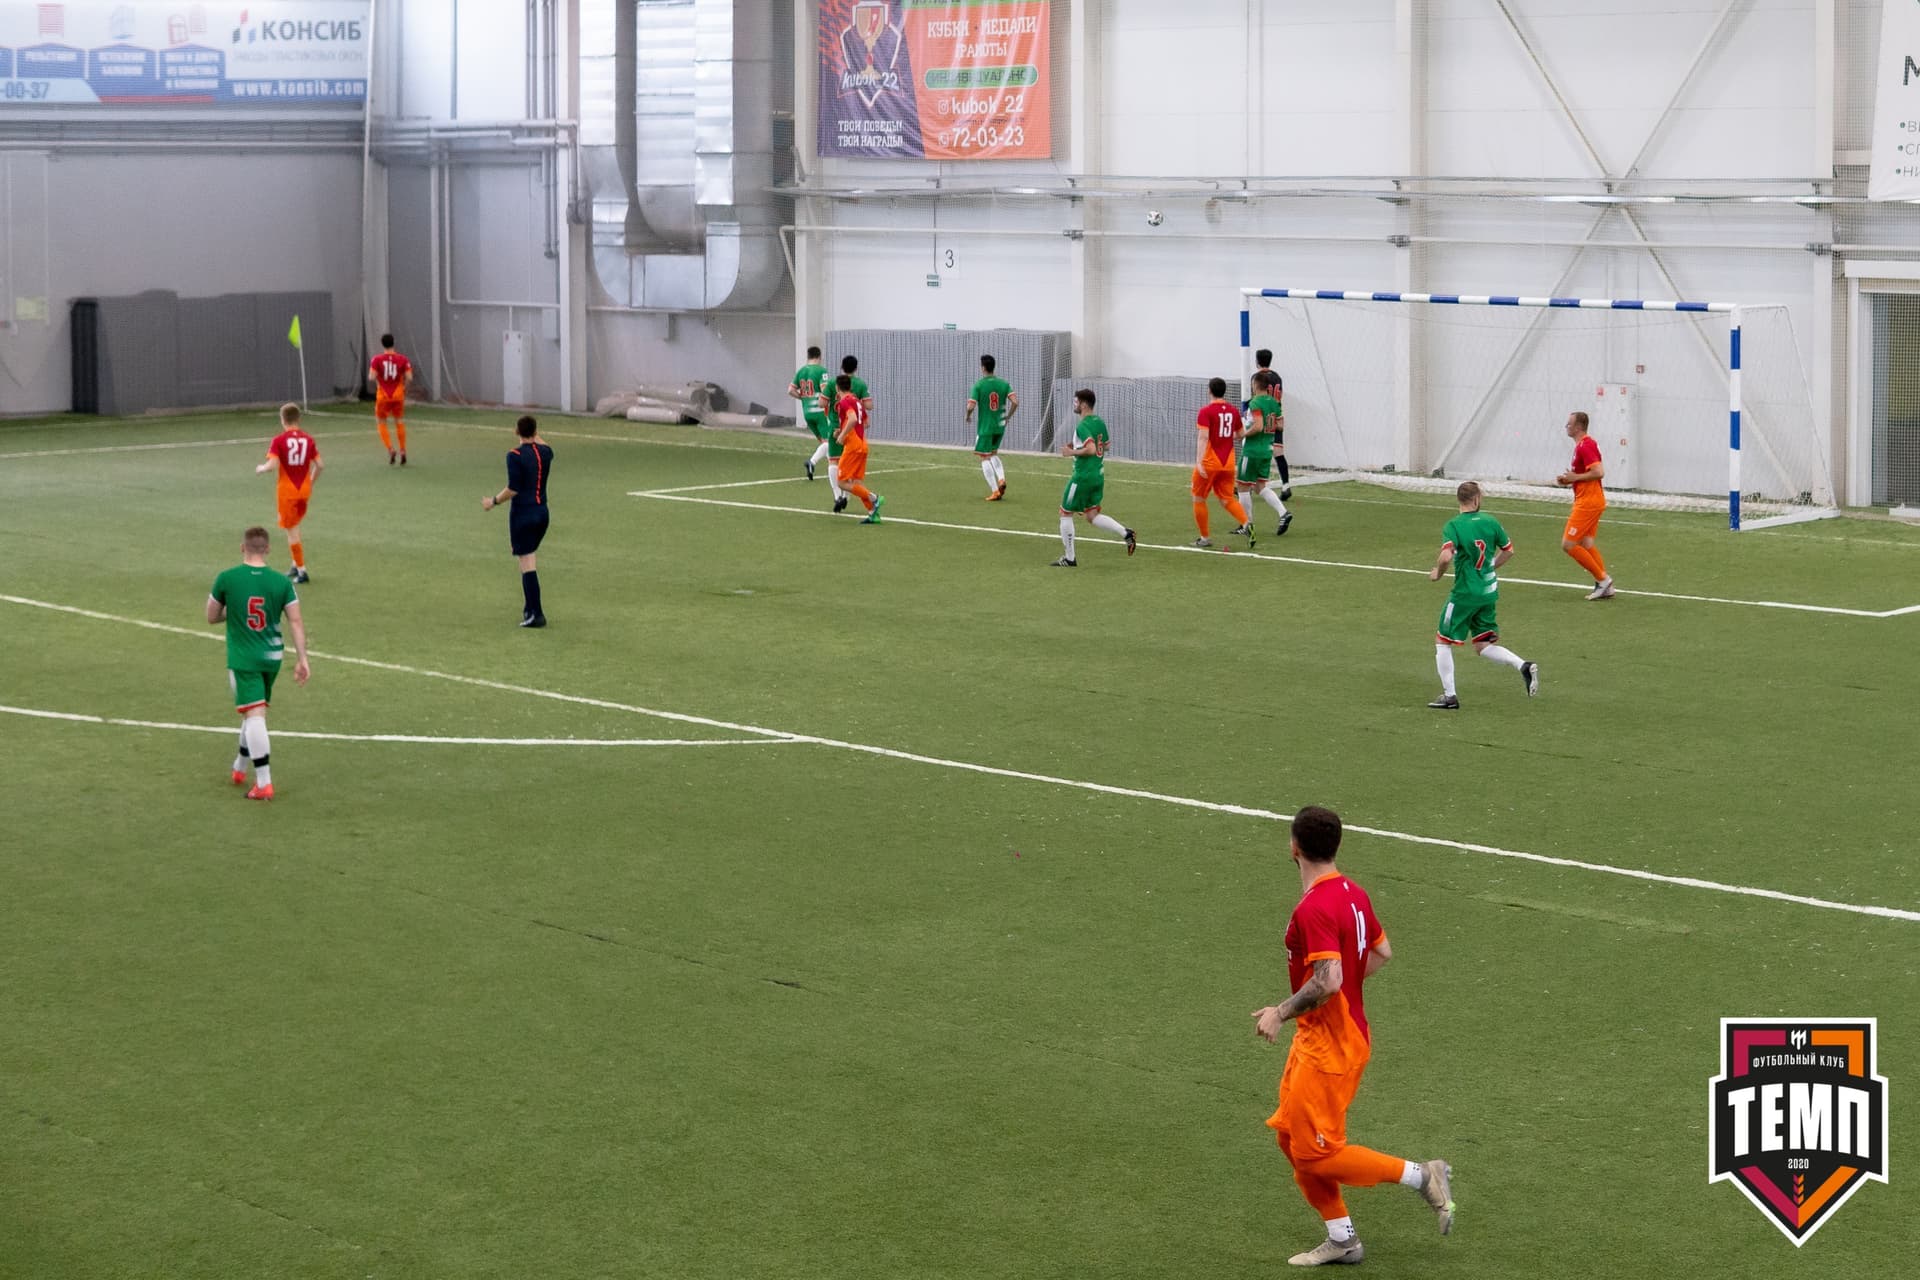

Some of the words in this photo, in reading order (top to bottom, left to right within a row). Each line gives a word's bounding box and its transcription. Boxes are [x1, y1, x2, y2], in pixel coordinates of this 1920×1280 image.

[262, 20, 361, 41] КОНСИБ
[927, 20, 970, 38] КУБКИ
[981, 16, 1037, 36] МЕДАЛИ
[233, 80, 365, 97] www.konsib.com
[951, 95, 1024, 117] kubok_22
[838, 119, 860, 132] ТВОИ
[838, 135, 860, 147] ТВОИ
[952, 126, 1025, 147] 72-03-23
[945, 249, 954, 268] 3
[383, 360, 398, 381] 14
[989, 391, 999, 411] 8
[1218, 412, 1233, 438] 13
[286, 437, 308, 466] 27
[1474, 540, 1487, 570] 7
[247, 596, 267, 632] 5
[1351, 903, 1367, 960] 4
